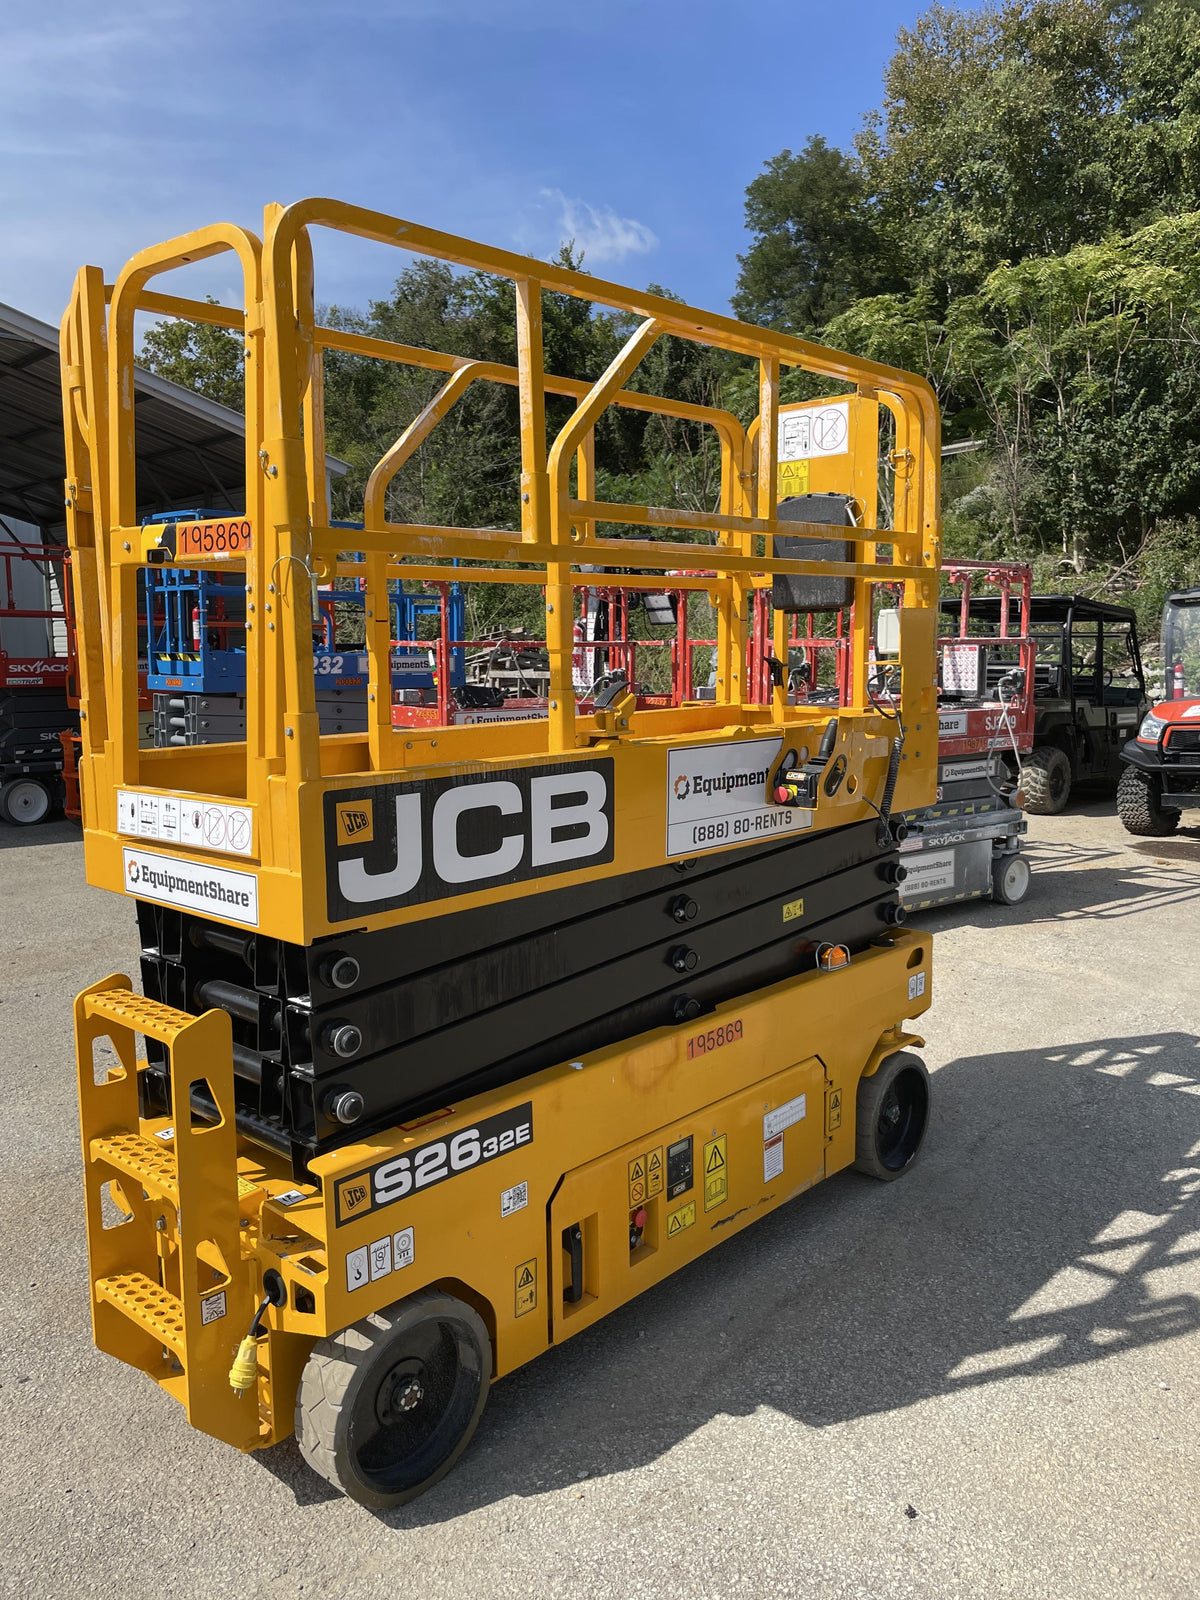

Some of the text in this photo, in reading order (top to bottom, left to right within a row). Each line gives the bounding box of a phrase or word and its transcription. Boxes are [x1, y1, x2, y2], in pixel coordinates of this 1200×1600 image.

[181, 521, 251, 553] 195869
[9, 661, 68, 674] SKYJACK
[693, 768, 770, 796] Equipment
[338, 770, 609, 903] JCB
[346, 813, 368, 833] JCB
[693, 810, 792, 844] (888) 80-RENTS
[929, 834, 966, 847] SKYJACK
[905, 860, 952, 874] EquipmentShare
[141, 865, 249, 907] EquipmentShare
[689, 1019, 743, 1058] 195869
[347, 1186, 366, 1207] JCB
